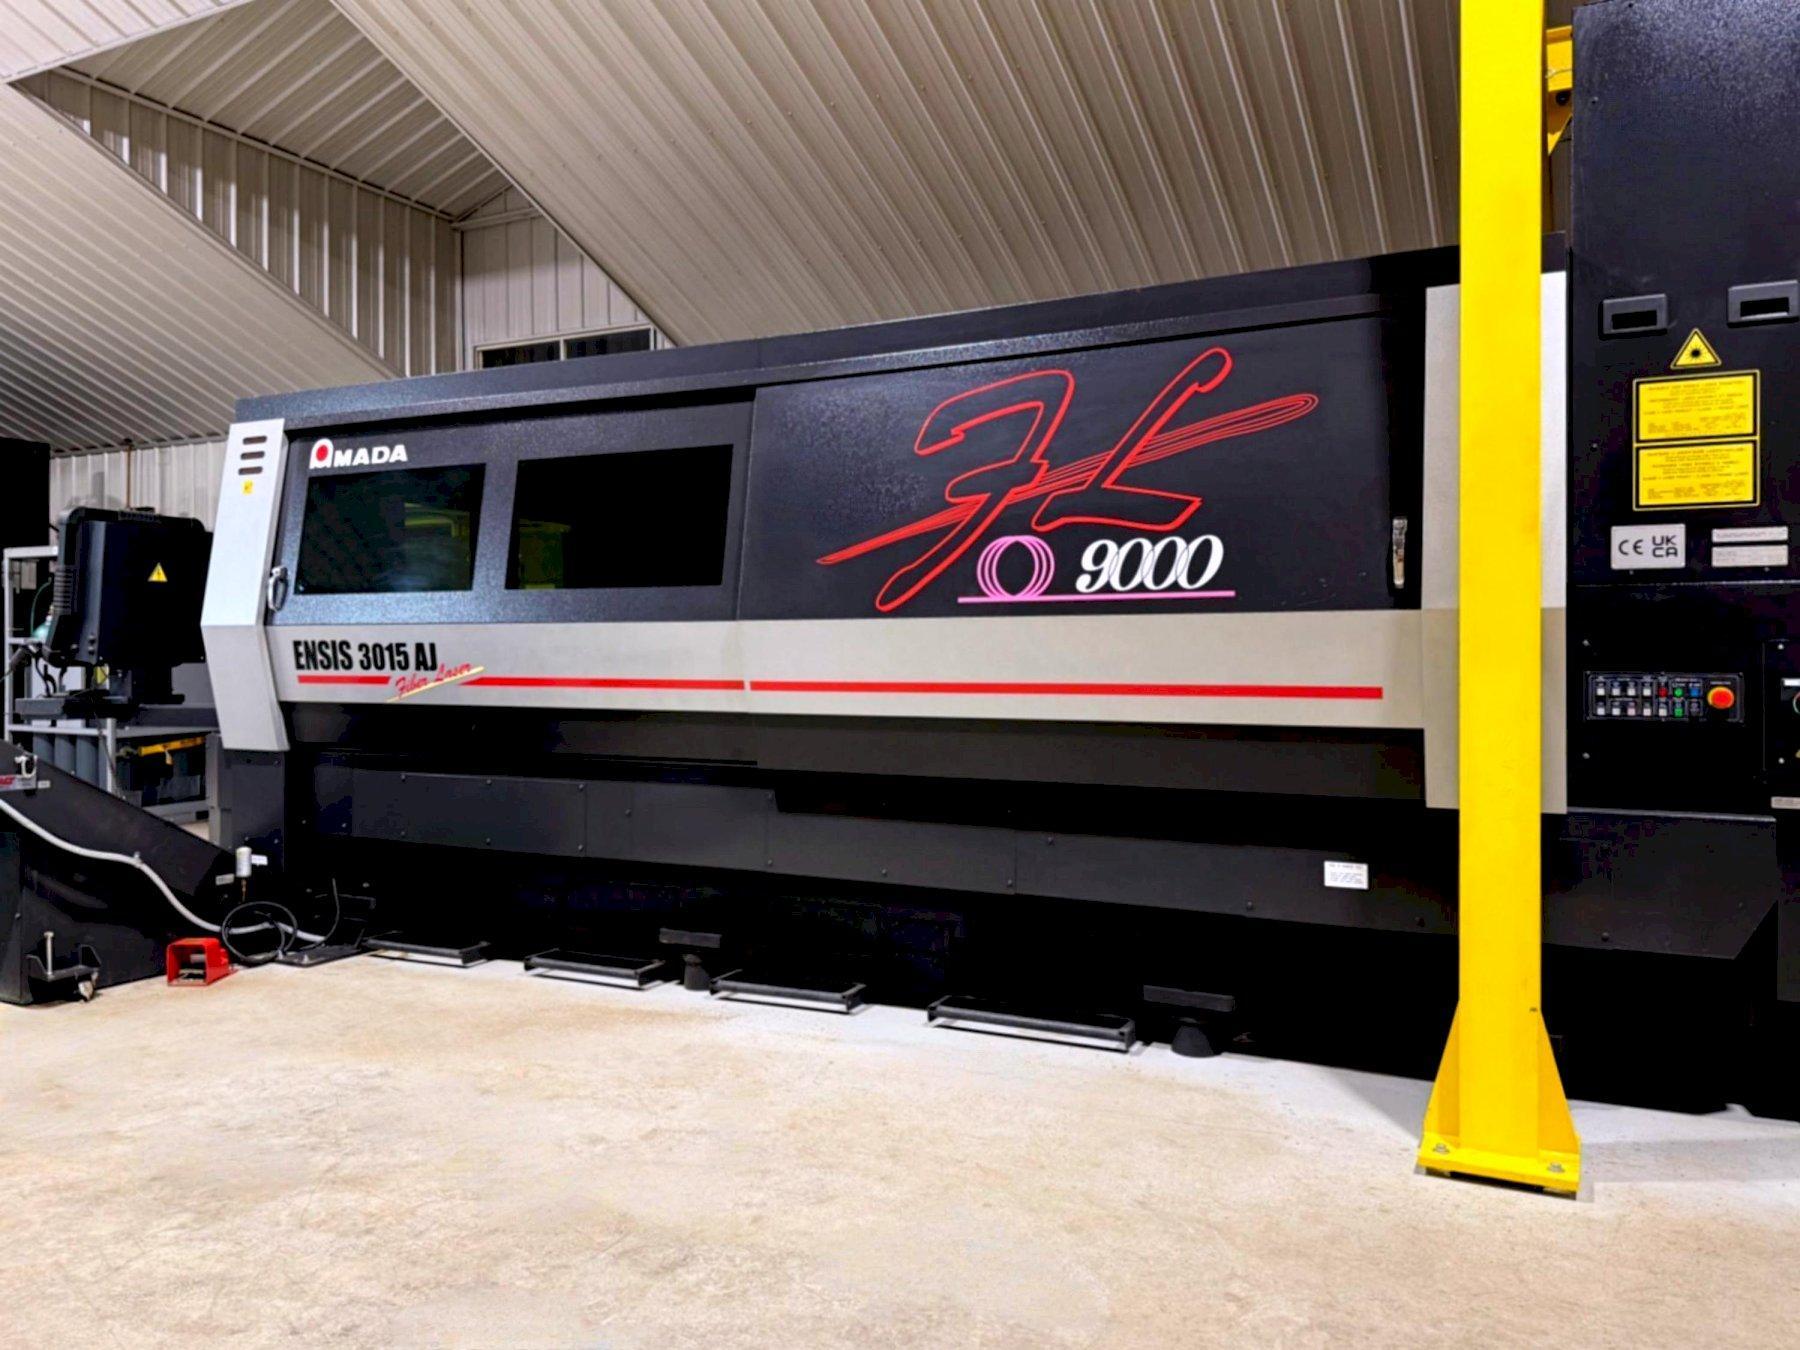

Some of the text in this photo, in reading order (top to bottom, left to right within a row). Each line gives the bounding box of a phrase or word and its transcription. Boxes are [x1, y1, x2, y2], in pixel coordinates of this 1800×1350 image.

[309, 438, 408, 469] AMADA
[1618, 539, 1644, 555] CE
[1652, 535, 1677, 547] UK
[1652, 547, 1678, 558] CA
[1075, 535, 1224, 593] 9000
[293, 640, 437, 671] ENSIS 3015 AJ
[395, 663, 472, 697] Fiber Laser
